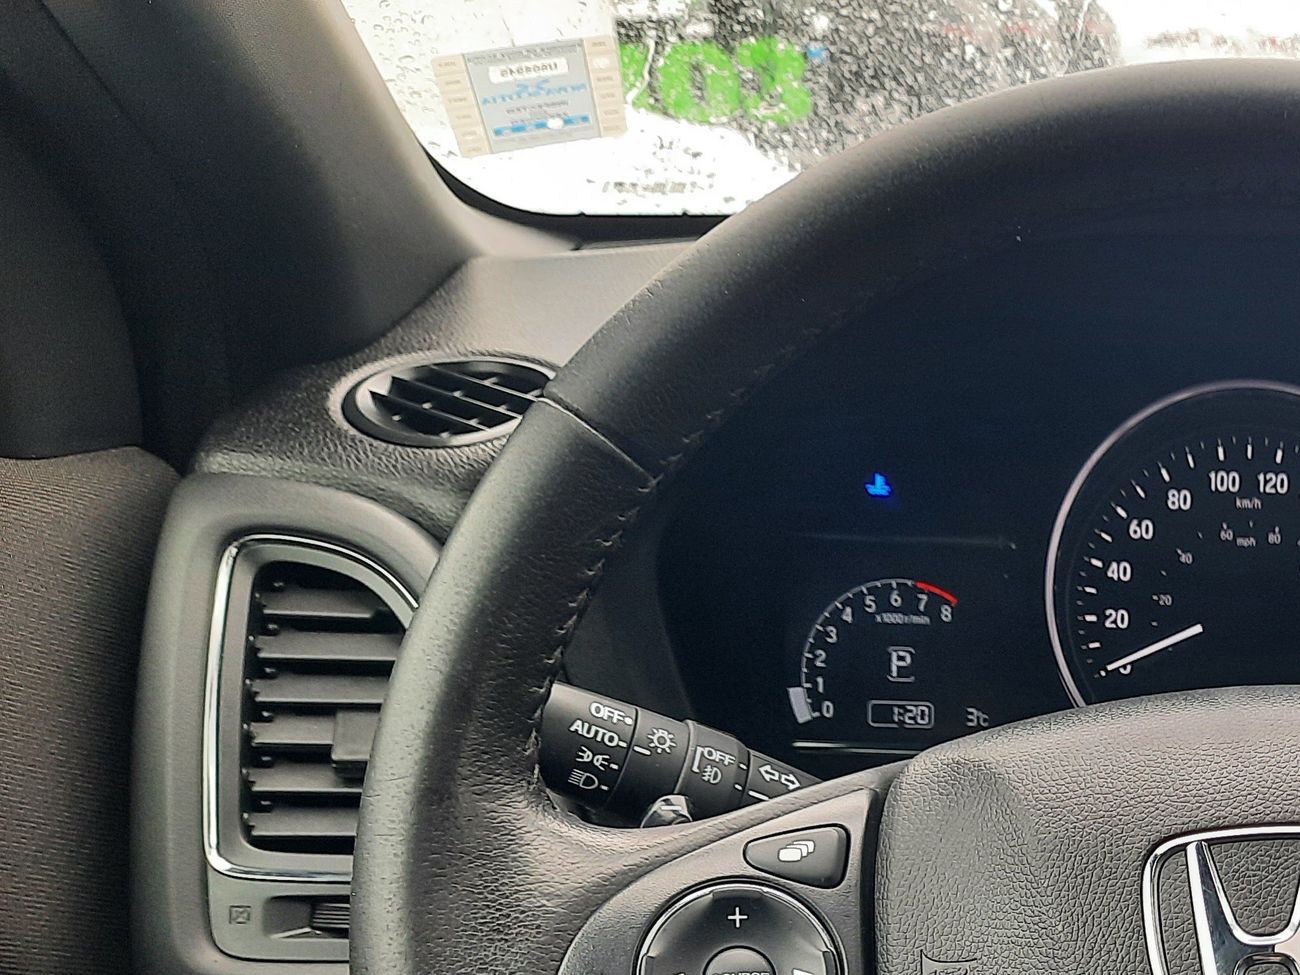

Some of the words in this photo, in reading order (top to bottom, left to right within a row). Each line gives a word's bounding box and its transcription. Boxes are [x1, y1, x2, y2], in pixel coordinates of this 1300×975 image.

[1209, 470, 1240, 492] 100
[1258, 472, 1288, 494] 120
[1167, 489, 1191, 510] 80
[1236, 497, 1262, 509] km/h
[1129, 519, 1154, 540] 60
[1219, 529, 1234, 542] 60
[1236, 536, 1256, 548] mph
[1107, 561, 1131, 582] 40
[863, 595, 877, 613] 5
[890, 590, 902, 607] 6
[916, 593, 929, 611] 7
[1159, 594, 1173, 606] 20
[841, 606, 853, 624] 4
[939, 603, 953, 623] 8
[1104, 609, 1129, 629] 20
[825, 626, 838, 644] 3
[813, 650, 828, 668] 2
[890, 652, 912, 678] P
[815, 677, 825, 694] 1
[588, 700, 626, 724] OFF
[820, 701, 835, 719] 0
[891, 705, 930, 724] 1:20
[569, 719, 619, 747] AUTO
[703, 746, 736, 767] OFF
